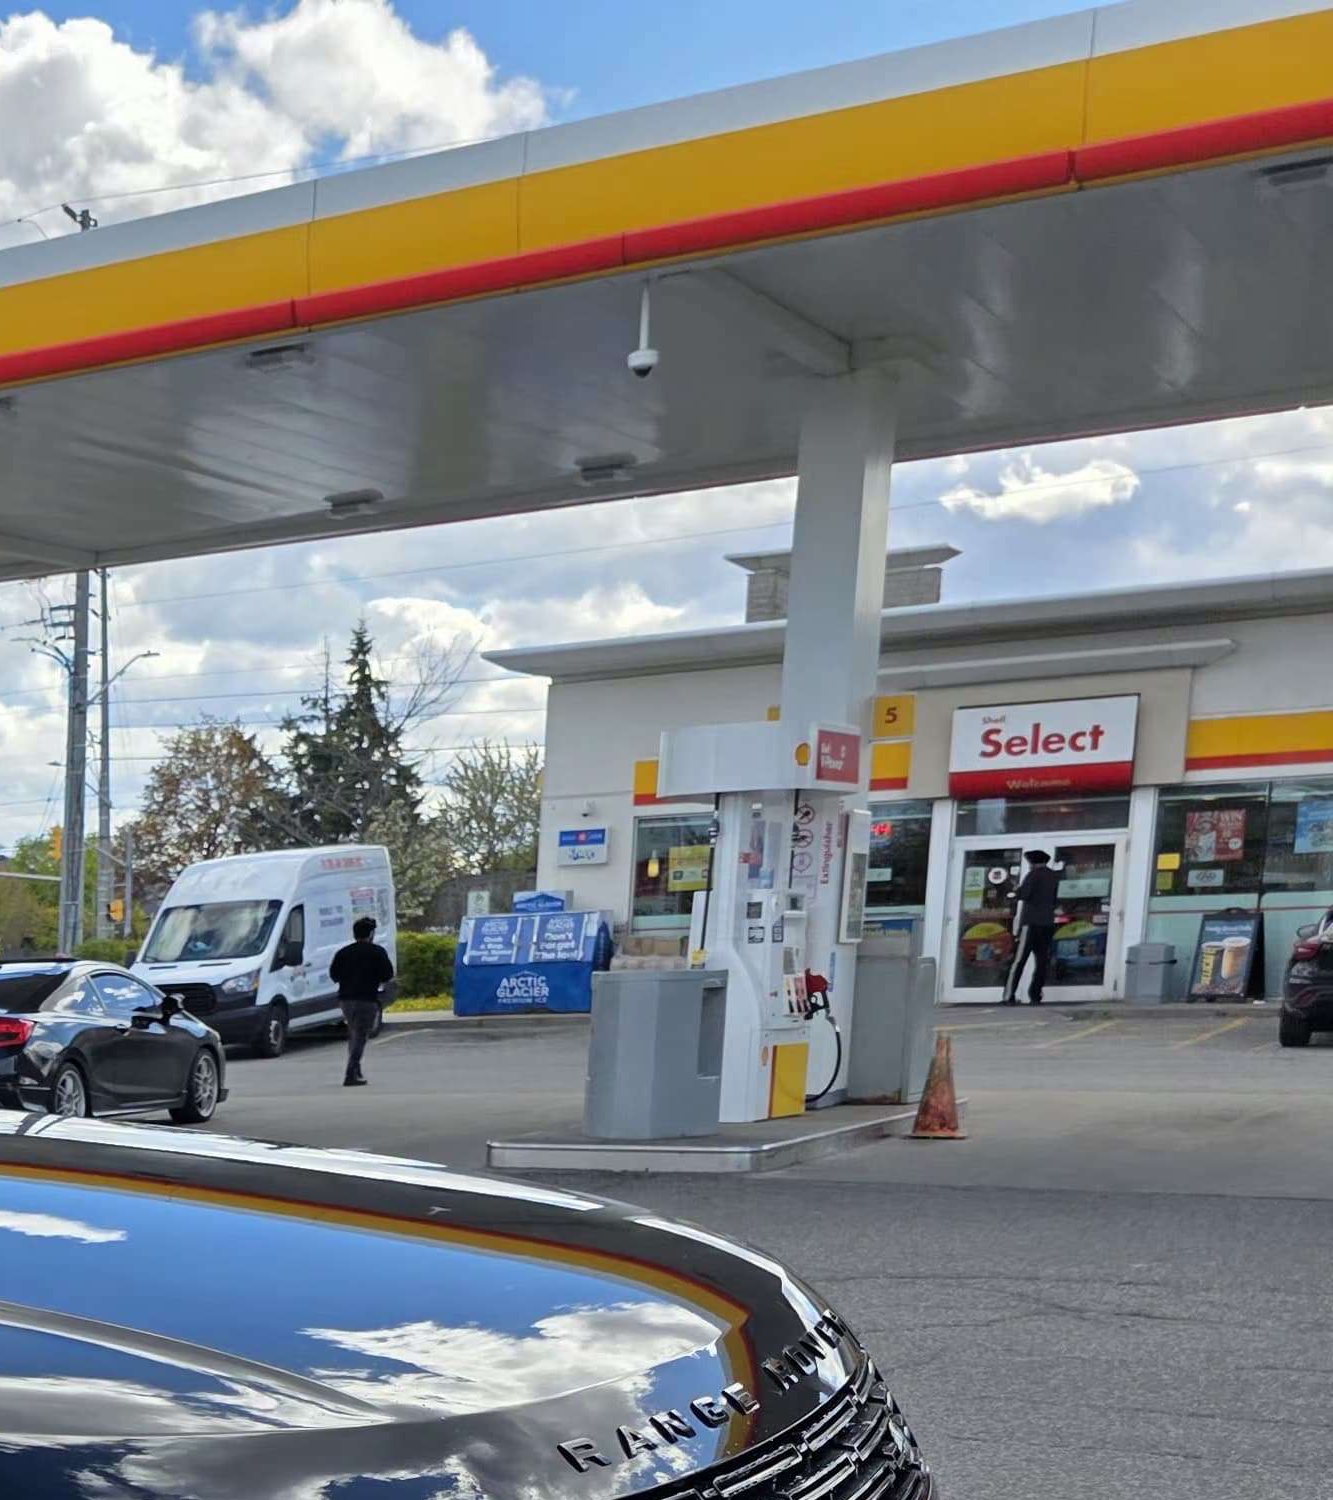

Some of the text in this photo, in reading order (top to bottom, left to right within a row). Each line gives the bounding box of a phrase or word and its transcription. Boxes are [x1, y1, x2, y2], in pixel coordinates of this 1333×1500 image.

[885, 707, 898, 724] 5
[979, 722, 1105, 759] Select
[1006, 778, 1071, 791] Welcome
[499, 976, 547, 988] ARCTIC
[496, 986, 550, 998] GLACIER
[557, 1381, 762, 1473] RANGE
